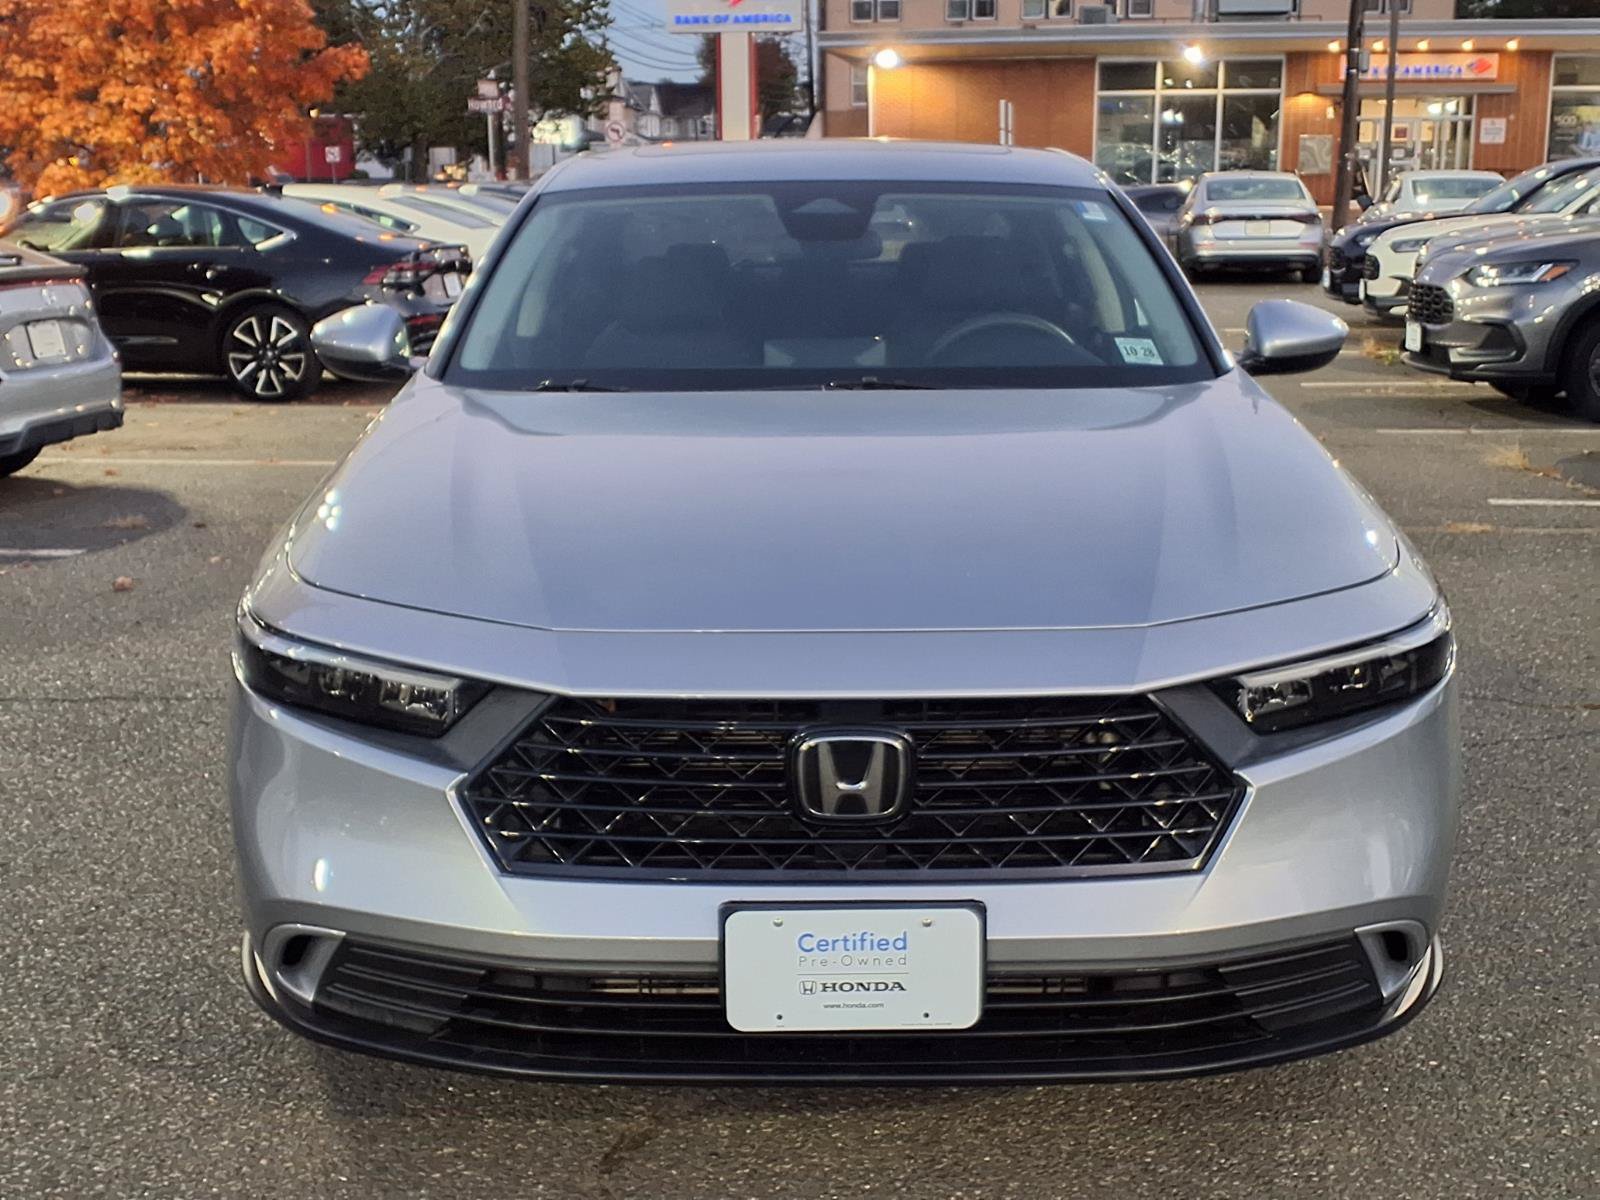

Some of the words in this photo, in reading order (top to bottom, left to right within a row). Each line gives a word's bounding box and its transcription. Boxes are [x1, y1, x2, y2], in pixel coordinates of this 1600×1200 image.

[674, 15, 710, 25] BANK
[713, 14, 730, 24] OF
[733, 13, 792, 24] AMERICA
[1404, 65, 1463, 76] AMERICA
[797, 931, 907, 953] Certified
[798, 954, 907, 967] Pre-Owned
[820, 981, 907, 993] HONDA
